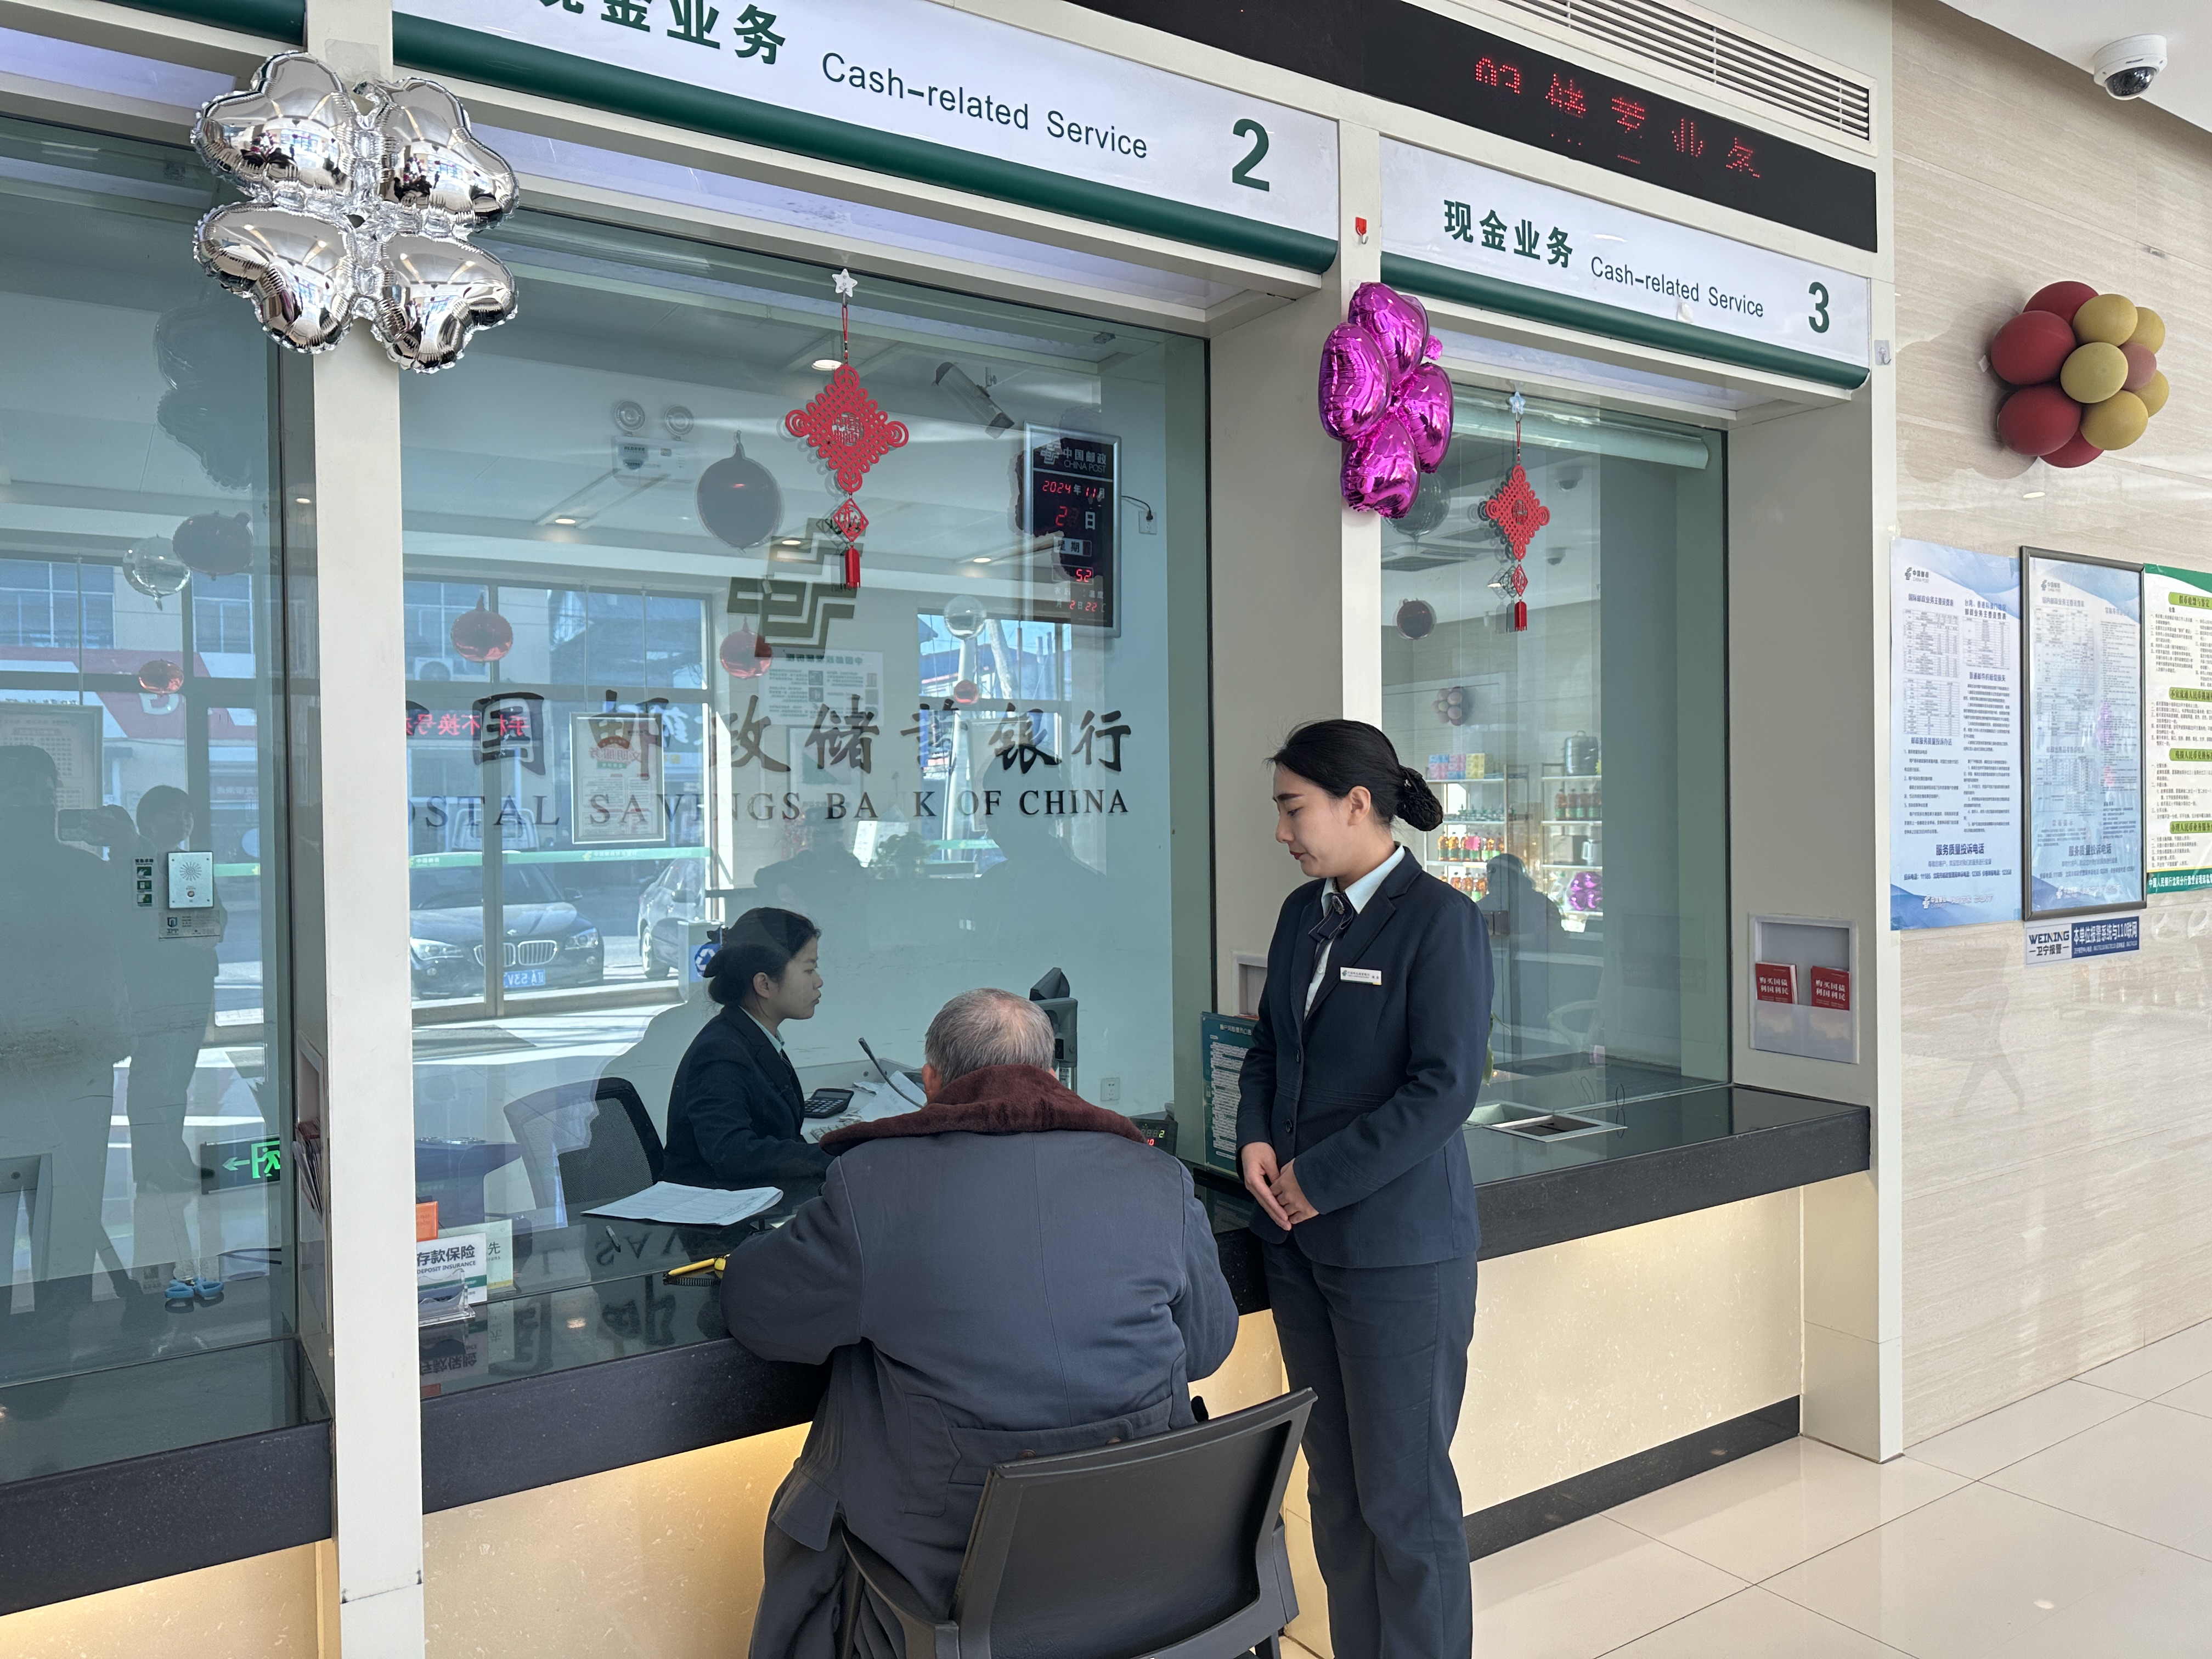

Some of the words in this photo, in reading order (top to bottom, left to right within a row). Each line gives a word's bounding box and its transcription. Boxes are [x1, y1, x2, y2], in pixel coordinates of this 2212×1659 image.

[540, 0, 786, 65] 金业务
[822, 52, 1030, 130] Cash-related
[1047, 110, 1148, 159] Service
[1232, 118, 1270, 192] 2
[1443, 199, 1573, 268] 现金业务
[1591, 256, 1699, 302] Cash-related
[1708, 286, 1764, 318] Service
[1808, 281, 1830, 334] 3
[1063, 447, 1107, 465] 中国邮政
[1063, 459, 1087, 471] CHINA
[1088, 464, 1107, 473] POST
[1076, 568, 1092, 583] 52
[957, 789, 1002, 817] OF
[1018, 788, 1128, 816] CHINA
[1936, 843, 1984, 856] 服务质量投诉电话
[2029, 930, 2070, 945] WEINING
[2073, 921, 2137, 945] 本单位报警系统与110联网
[2036, 943, 2062, 956] 卫宁报警
[1759, 976, 1788, 987] 购买国债
[1815, 979, 1846, 992] 购买国债
[1760, 985, 1789, 996] 利国利民
[1815, 988, 1846, 1001] 利国利民
[416, 1244, 476, 1267] 存款保险
[417, 1266, 442, 1274] DEPOSIT
[442, 1260, 476, 1271] INSURANCE
